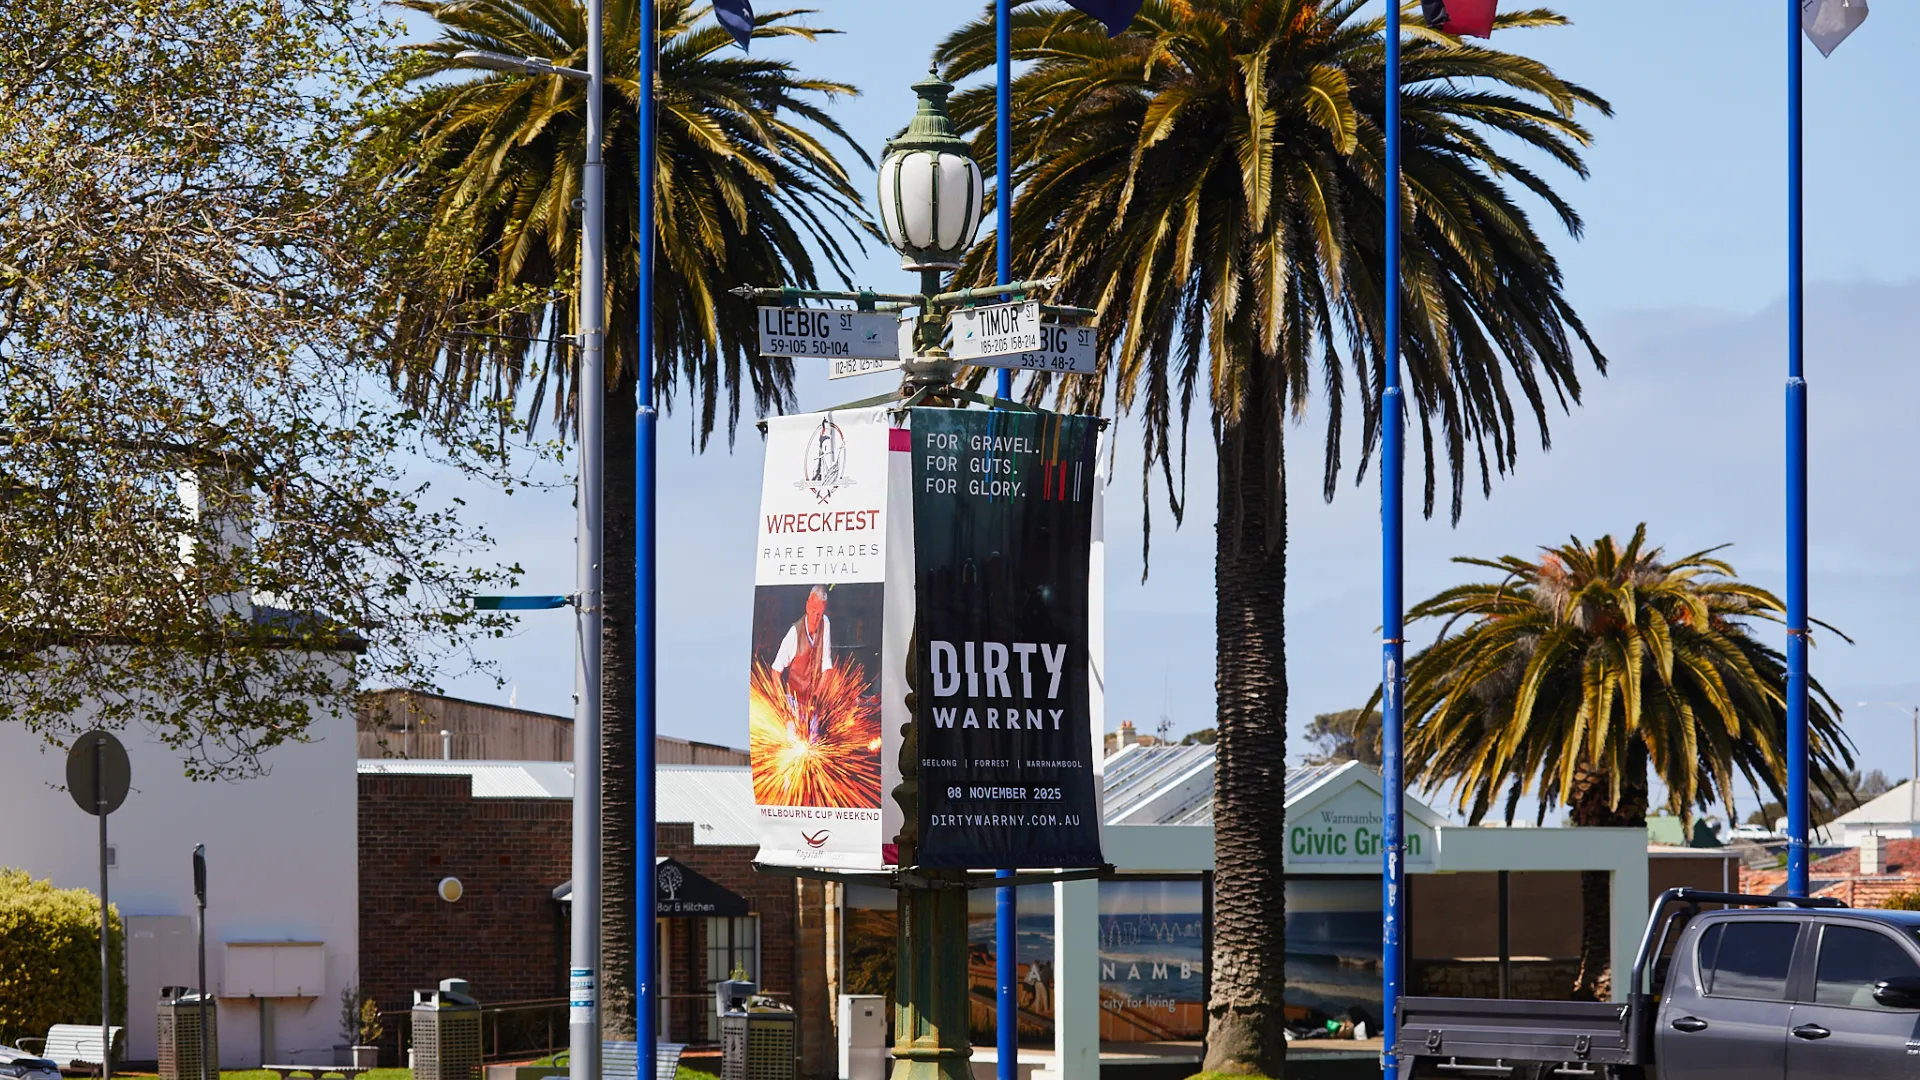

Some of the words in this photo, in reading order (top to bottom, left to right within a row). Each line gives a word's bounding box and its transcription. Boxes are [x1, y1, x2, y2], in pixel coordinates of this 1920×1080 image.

[765, 309, 830, 338] LIEBIG
[840, 313, 852, 328] ST
[979, 306, 1019, 337] TIMOR
[1026, 304, 1034, 319] ST
[771, 339, 807, 353] 59-105
[812, 341, 849, 356] 50-104
[980, 338, 1008, 354] 185-205
[1010, 335, 1036, 350] 158-214
[1040, 327, 1067, 353] BIG
[1078, 330, 1090, 343] ST
[1021, 354, 1045, 368] 53-3
[1051, 357, 1075, 370] 48-2
[927, 433, 958, 449] FOR
[971, 435, 1040, 454] GRAVEL.
[926, 455, 957, 472] FOR
[970, 457, 1018, 475] GUTS.
[926, 477, 957, 494] FOR
[969, 480, 1026, 497] GLORY.
[767, 510, 880, 534] WRECKFEST
[763, 547, 805, 559] RARE
[816, 544, 879, 557] TRADES
[778, 563, 858, 575] FESTIVAL
[930, 640, 1067, 699] DIRTY
[932, 707, 1064, 730] WARRNY
[922, 759, 957, 767] GEELONG
[974, 759, 1010, 768] FORREST
[1026, 760, 1083, 768] WARRNAMBOOL
[947, 787, 962, 799] 08
[970, 787, 1027, 799] NOVEMBER
[1033, 788, 1062, 800] 2025
[760, 808, 813, 819] MELBOURNE
[815, 810, 833, 820] CUP
[835, 811, 880, 821] WEEKEND
[932, 815, 1080, 826] DIRTYWARRNY.COM.AU
[1321, 811, 1383, 824] Warrnambo
[1291, 827, 1347, 855] Civic
[1355, 827, 1421, 856] Grn
[657, 902, 672, 912] Bar
[674, 902, 681, 912] &
[683, 902, 715, 912] Kitchen
[1102, 997, 1124, 1013] city
[1127, 996, 1144, 1009] for
[1146, 994, 1176, 1013] living
